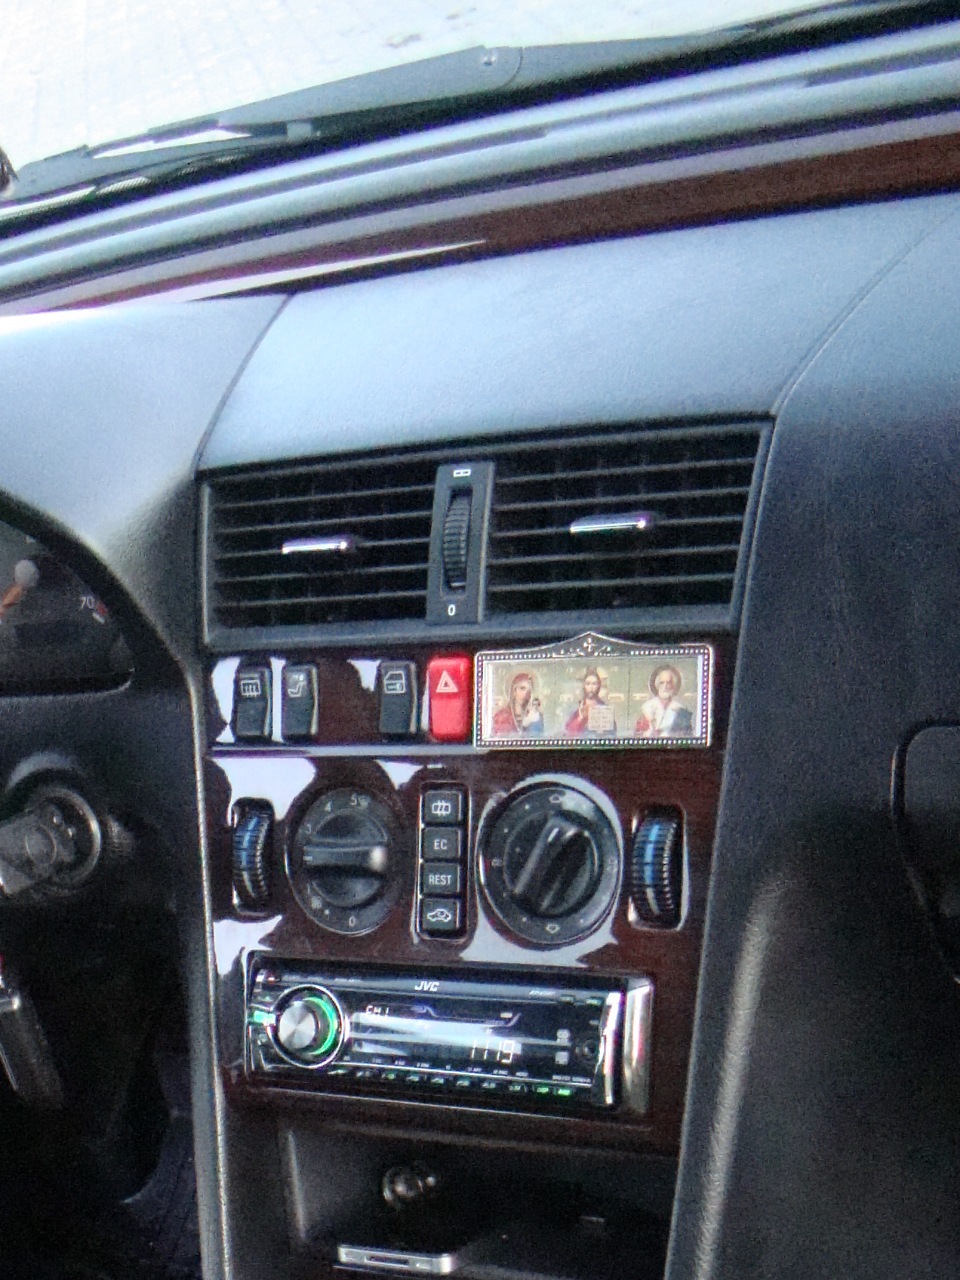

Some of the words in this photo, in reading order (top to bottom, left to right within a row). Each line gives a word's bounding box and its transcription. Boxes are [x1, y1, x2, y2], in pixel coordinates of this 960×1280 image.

[81, 596, 95, 609] 70
[325, 801, 332, 812] 4
[433, 839, 448, 850] EC
[428, 874, 452, 885] REST
[349, 916, 356, 927] 0
[414, 980, 440, 992] JVC
